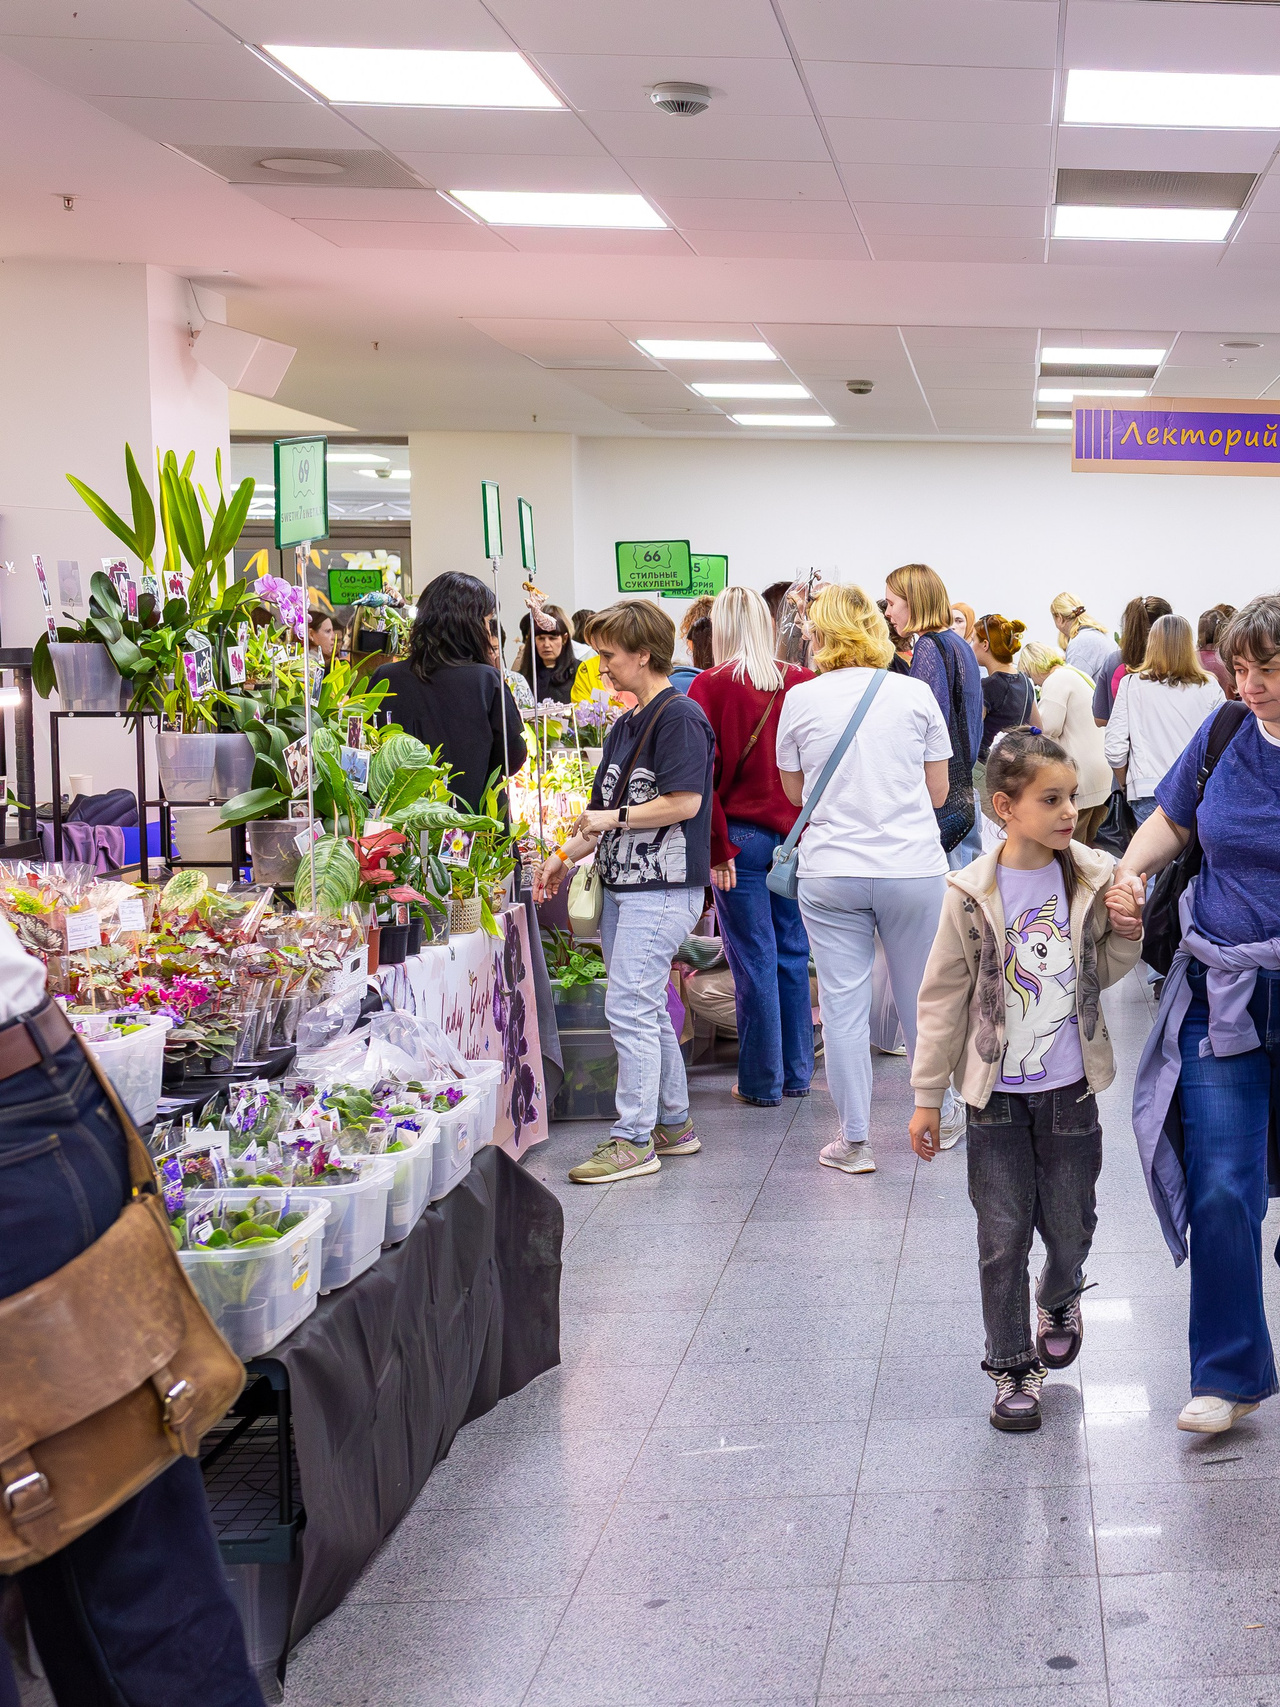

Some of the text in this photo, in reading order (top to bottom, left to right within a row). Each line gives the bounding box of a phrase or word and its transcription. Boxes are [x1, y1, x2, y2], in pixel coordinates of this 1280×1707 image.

[1120, 421, 1278, 455] Лекторий
[298, 459, 310, 483] 69
[643, 550, 661, 562] 66
[691, 562, 701, 573] 5
[343, 575, 373, 584] 60-63
[629, 571, 678, 580] СТИЛЬНЫЕ
[625, 579, 684, 589] СУККУЛЕНТЫ
